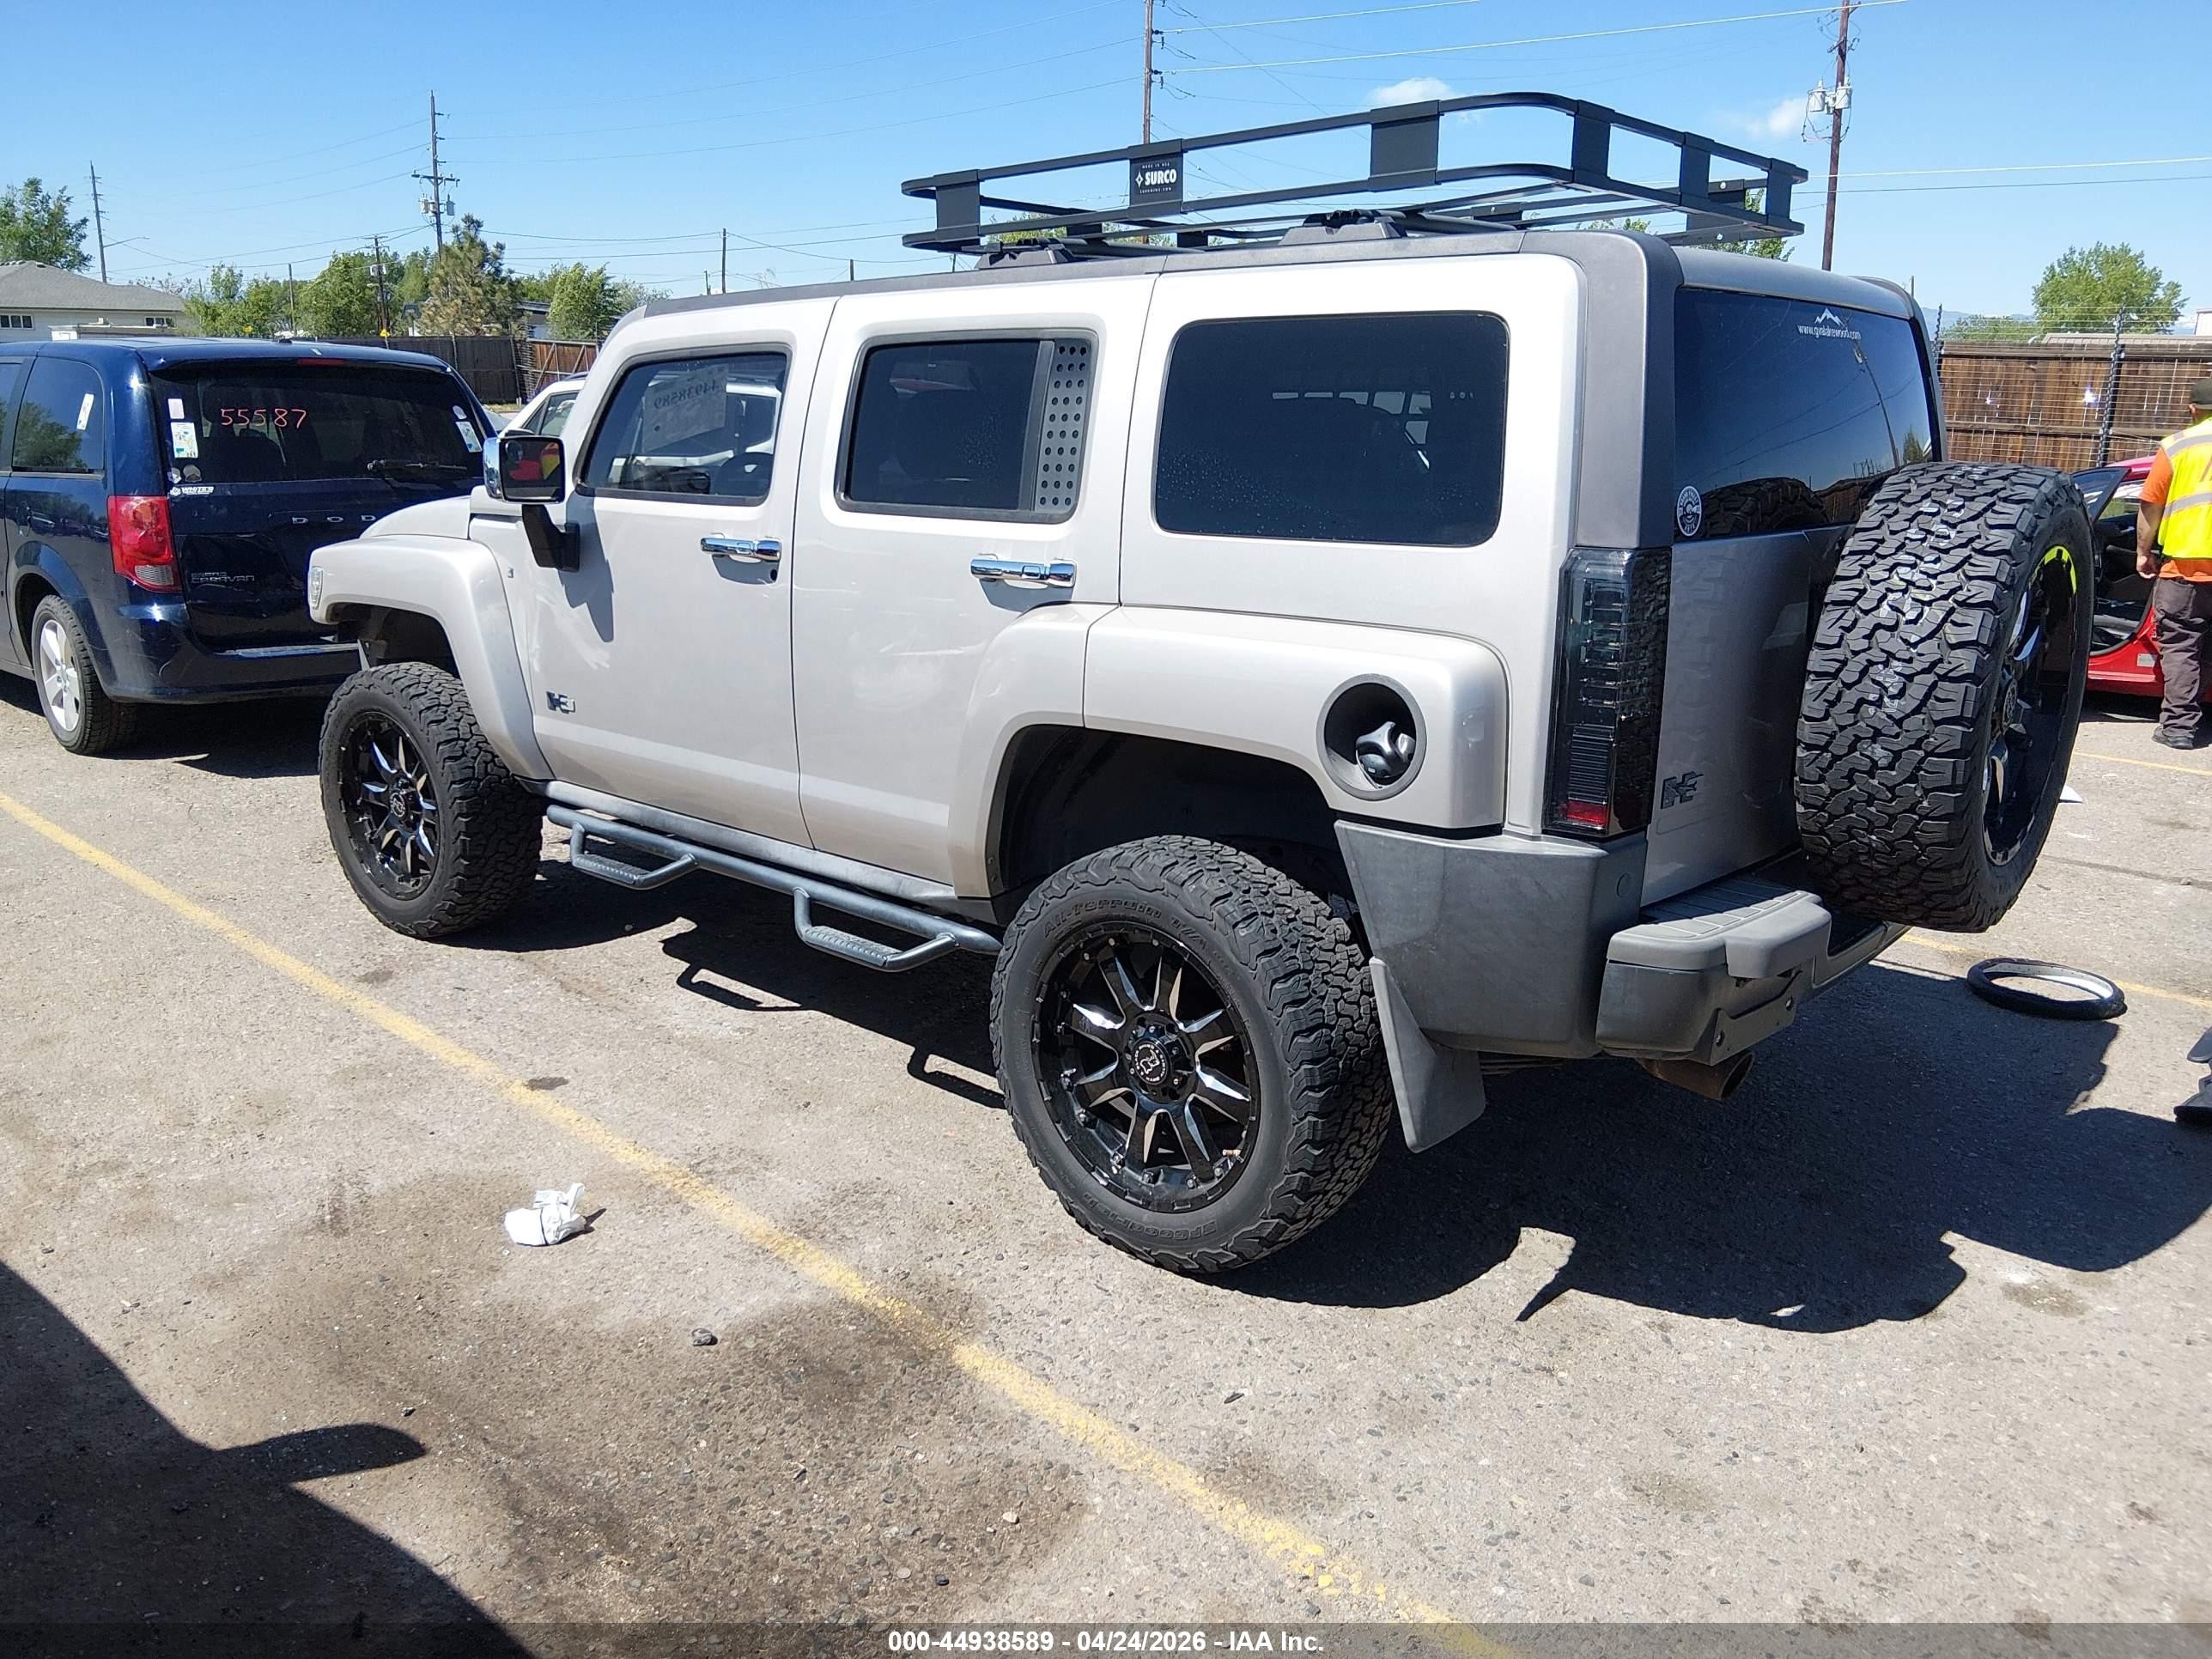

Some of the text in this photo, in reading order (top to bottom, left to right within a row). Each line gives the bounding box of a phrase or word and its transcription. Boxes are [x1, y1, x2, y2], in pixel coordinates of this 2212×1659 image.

[1145, 168, 1177, 186] SURCO
[220, 407, 307, 429] 55587
[292, 515, 376, 525] DOD
